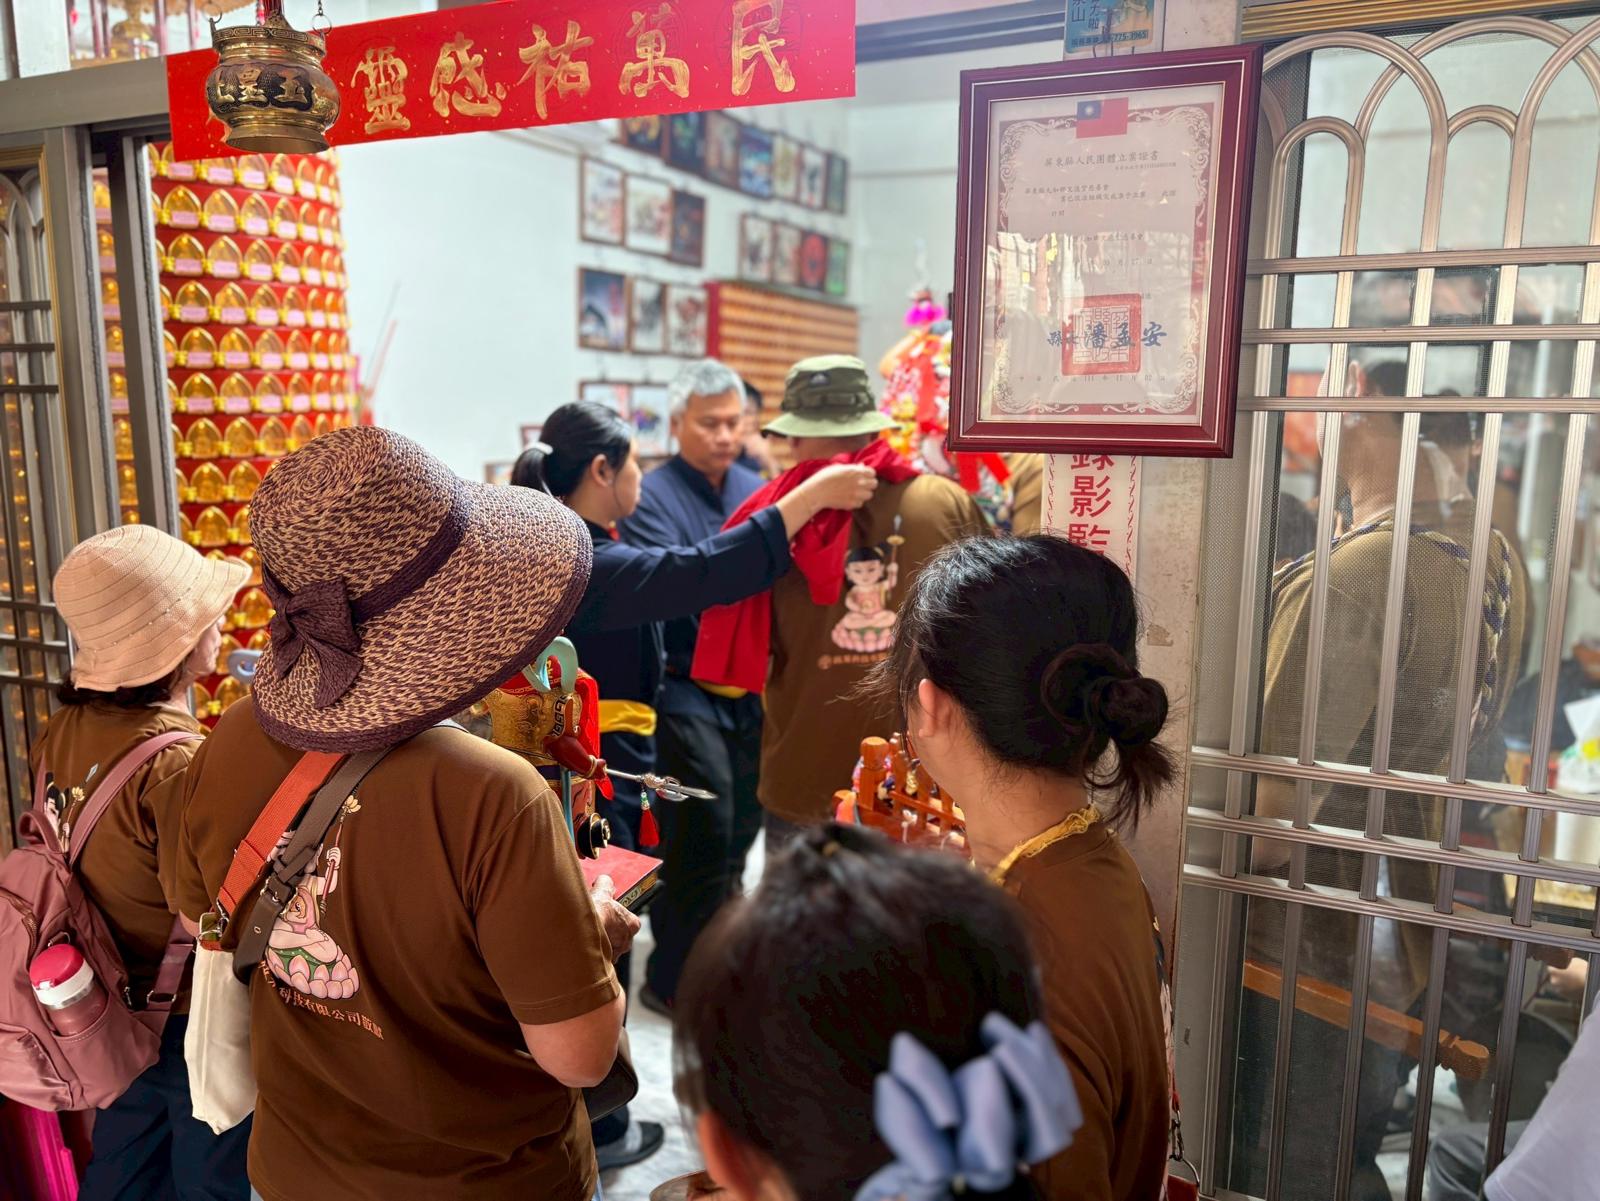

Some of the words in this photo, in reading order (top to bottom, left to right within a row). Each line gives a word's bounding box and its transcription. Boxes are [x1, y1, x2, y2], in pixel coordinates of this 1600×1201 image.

[205, 0, 796, 143] 靈感祐萬民
